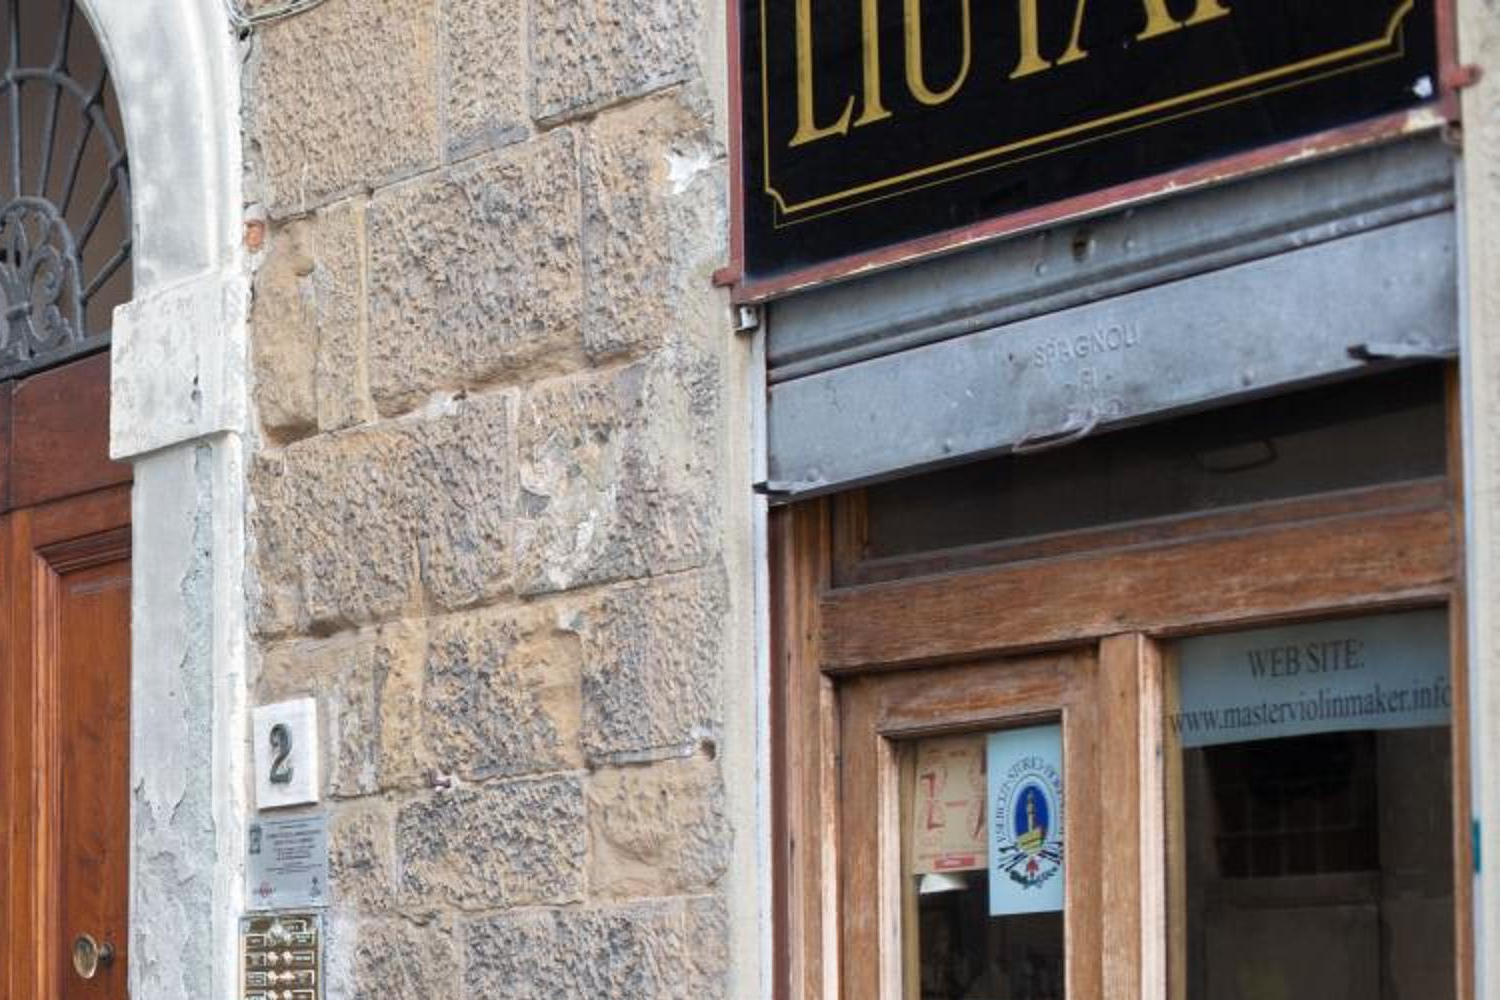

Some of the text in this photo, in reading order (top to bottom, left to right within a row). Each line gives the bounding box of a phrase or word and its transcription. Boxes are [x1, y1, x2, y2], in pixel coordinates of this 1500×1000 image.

[1248, 638, 1366, 678] WEB SITE:
[268, 722, 294, 785] 2
